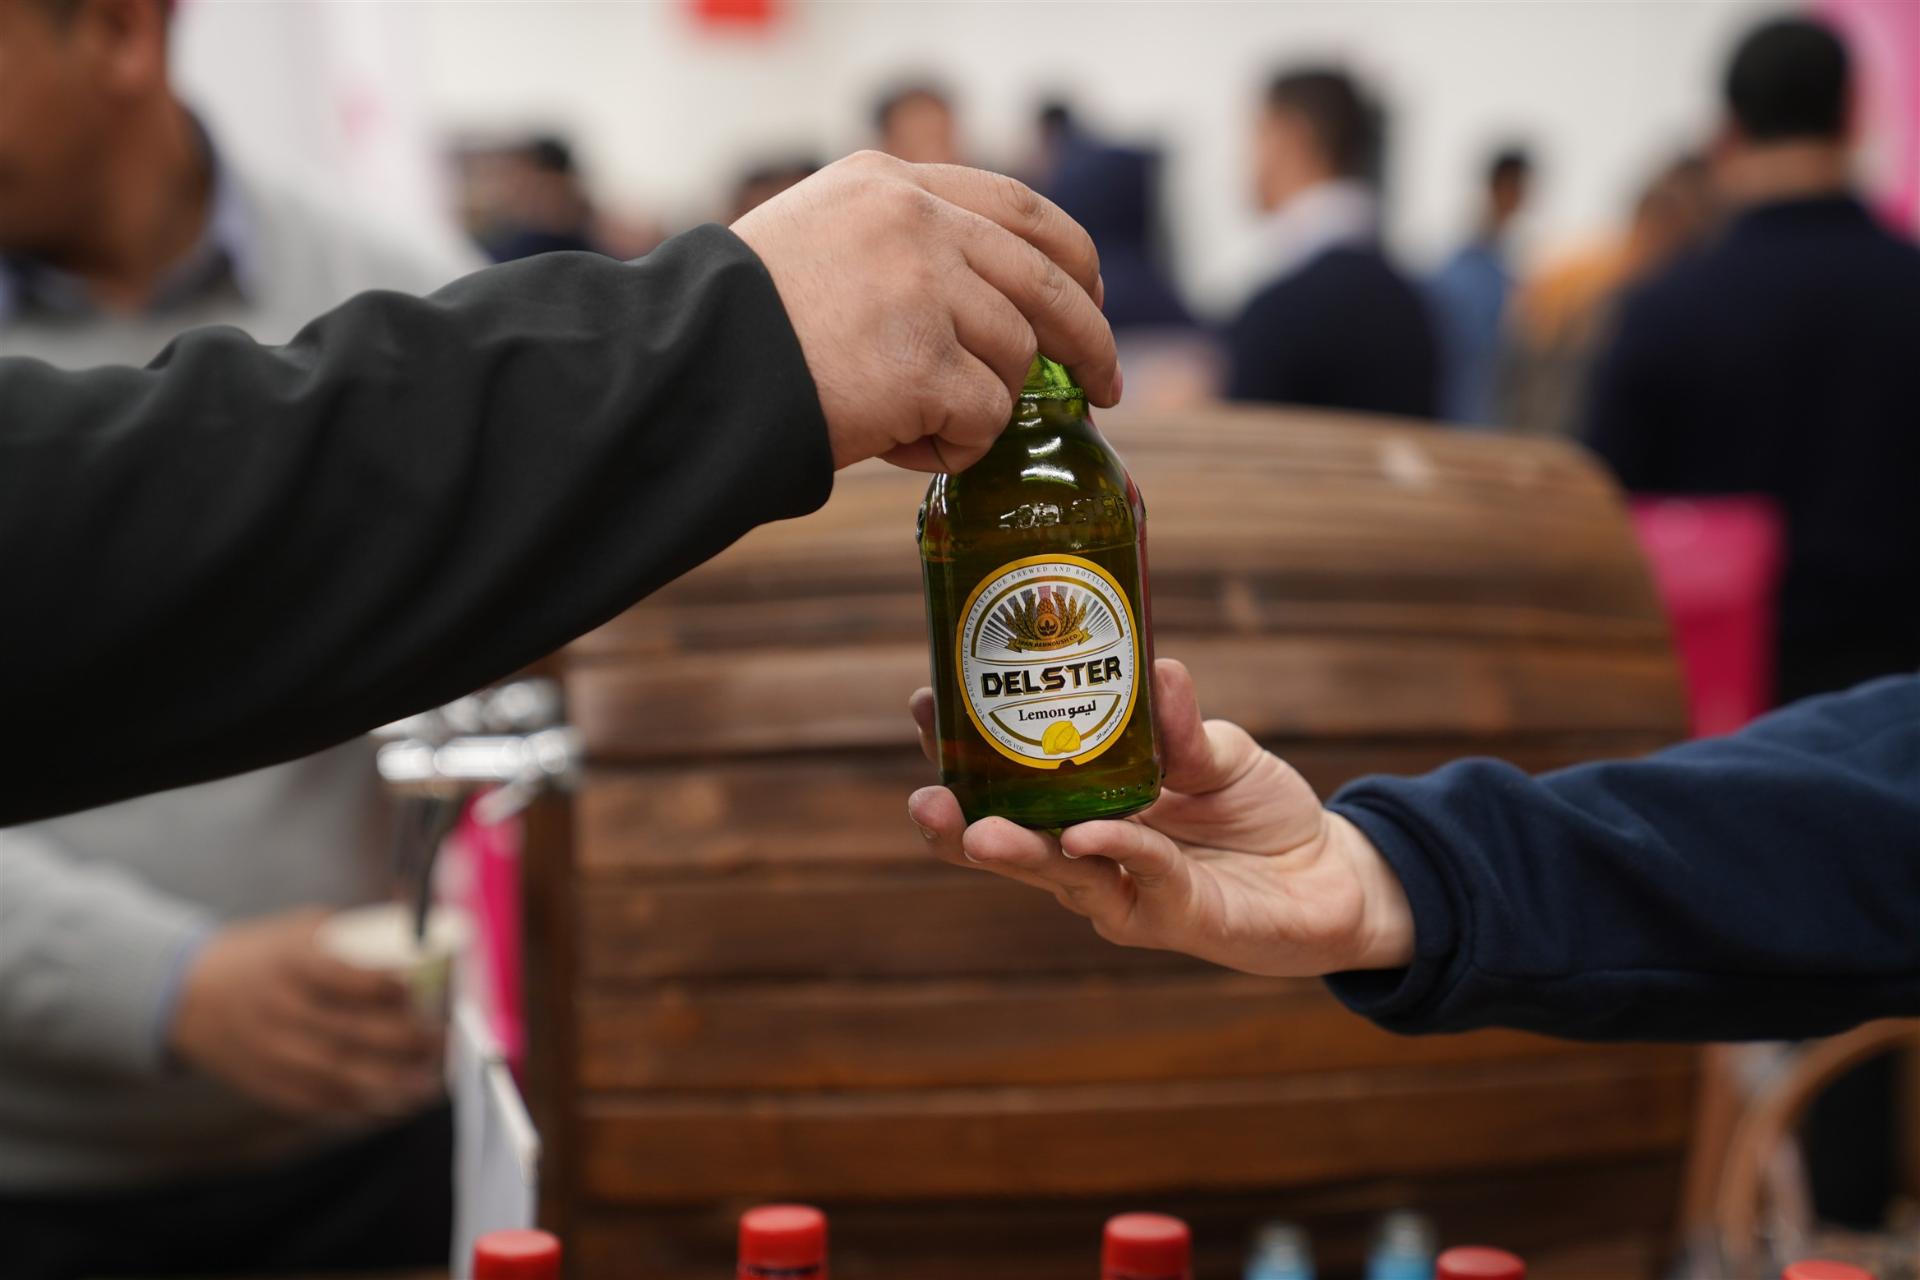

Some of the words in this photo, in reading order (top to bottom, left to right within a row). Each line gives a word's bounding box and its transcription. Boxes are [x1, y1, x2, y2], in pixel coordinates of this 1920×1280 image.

[1010, 566, 1048, 580] BREWED
[1075, 568, 1109, 592] BOTTLED
[974, 578, 1007, 614] BEVERAGE
[965, 615, 976, 639] MALT
[963, 643, 976, 698] ALCOHOLIC
[981, 655, 1123, 698] DELSTER
[974, 702, 986, 720] NON
[1018, 708, 1066, 722] Lemon
[1067, 700, 1097, 719] لیمو
